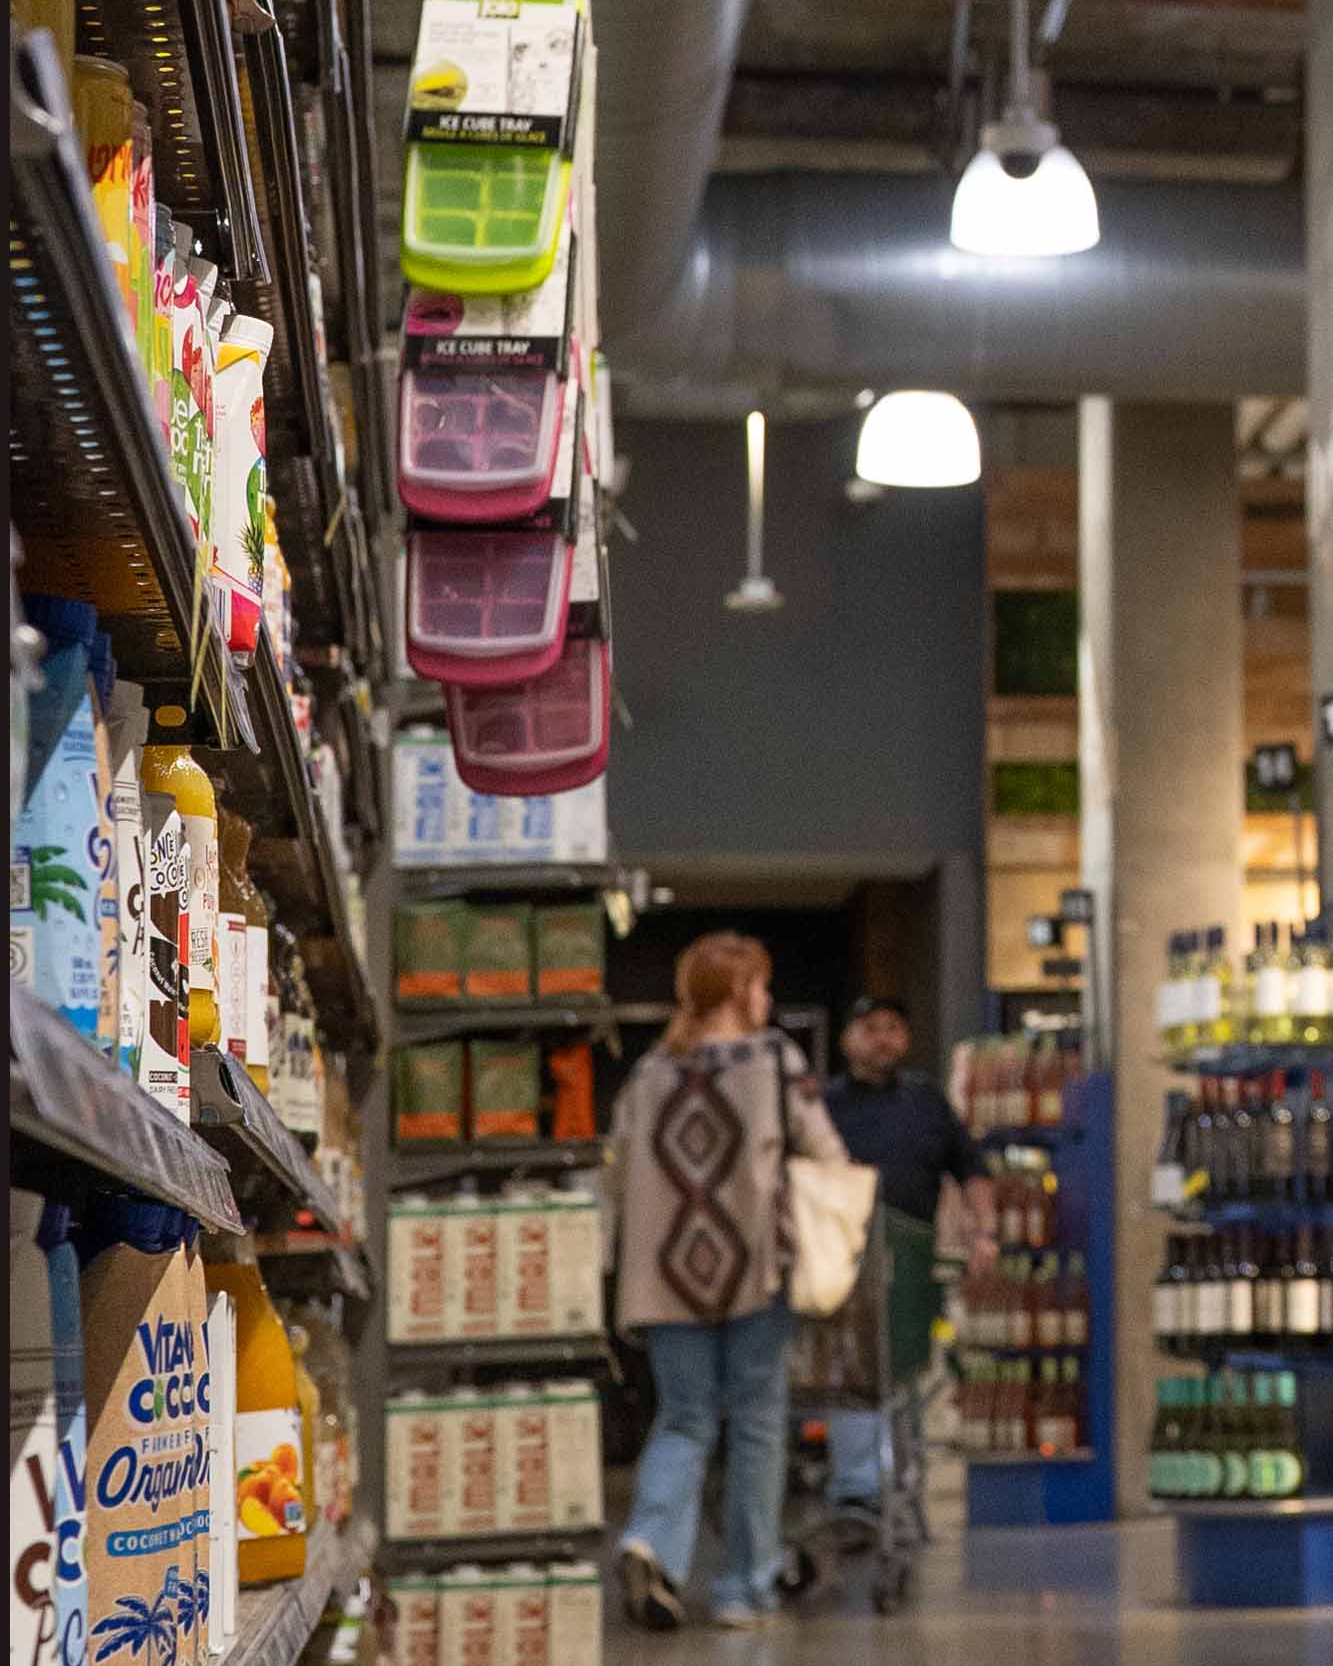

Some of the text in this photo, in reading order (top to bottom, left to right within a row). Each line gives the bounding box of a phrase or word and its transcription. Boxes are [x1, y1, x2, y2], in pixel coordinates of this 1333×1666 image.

[439, 115, 533, 132] ICE CUBE TRAY
[437, 340, 531, 355] ICE CUBE TRAY
